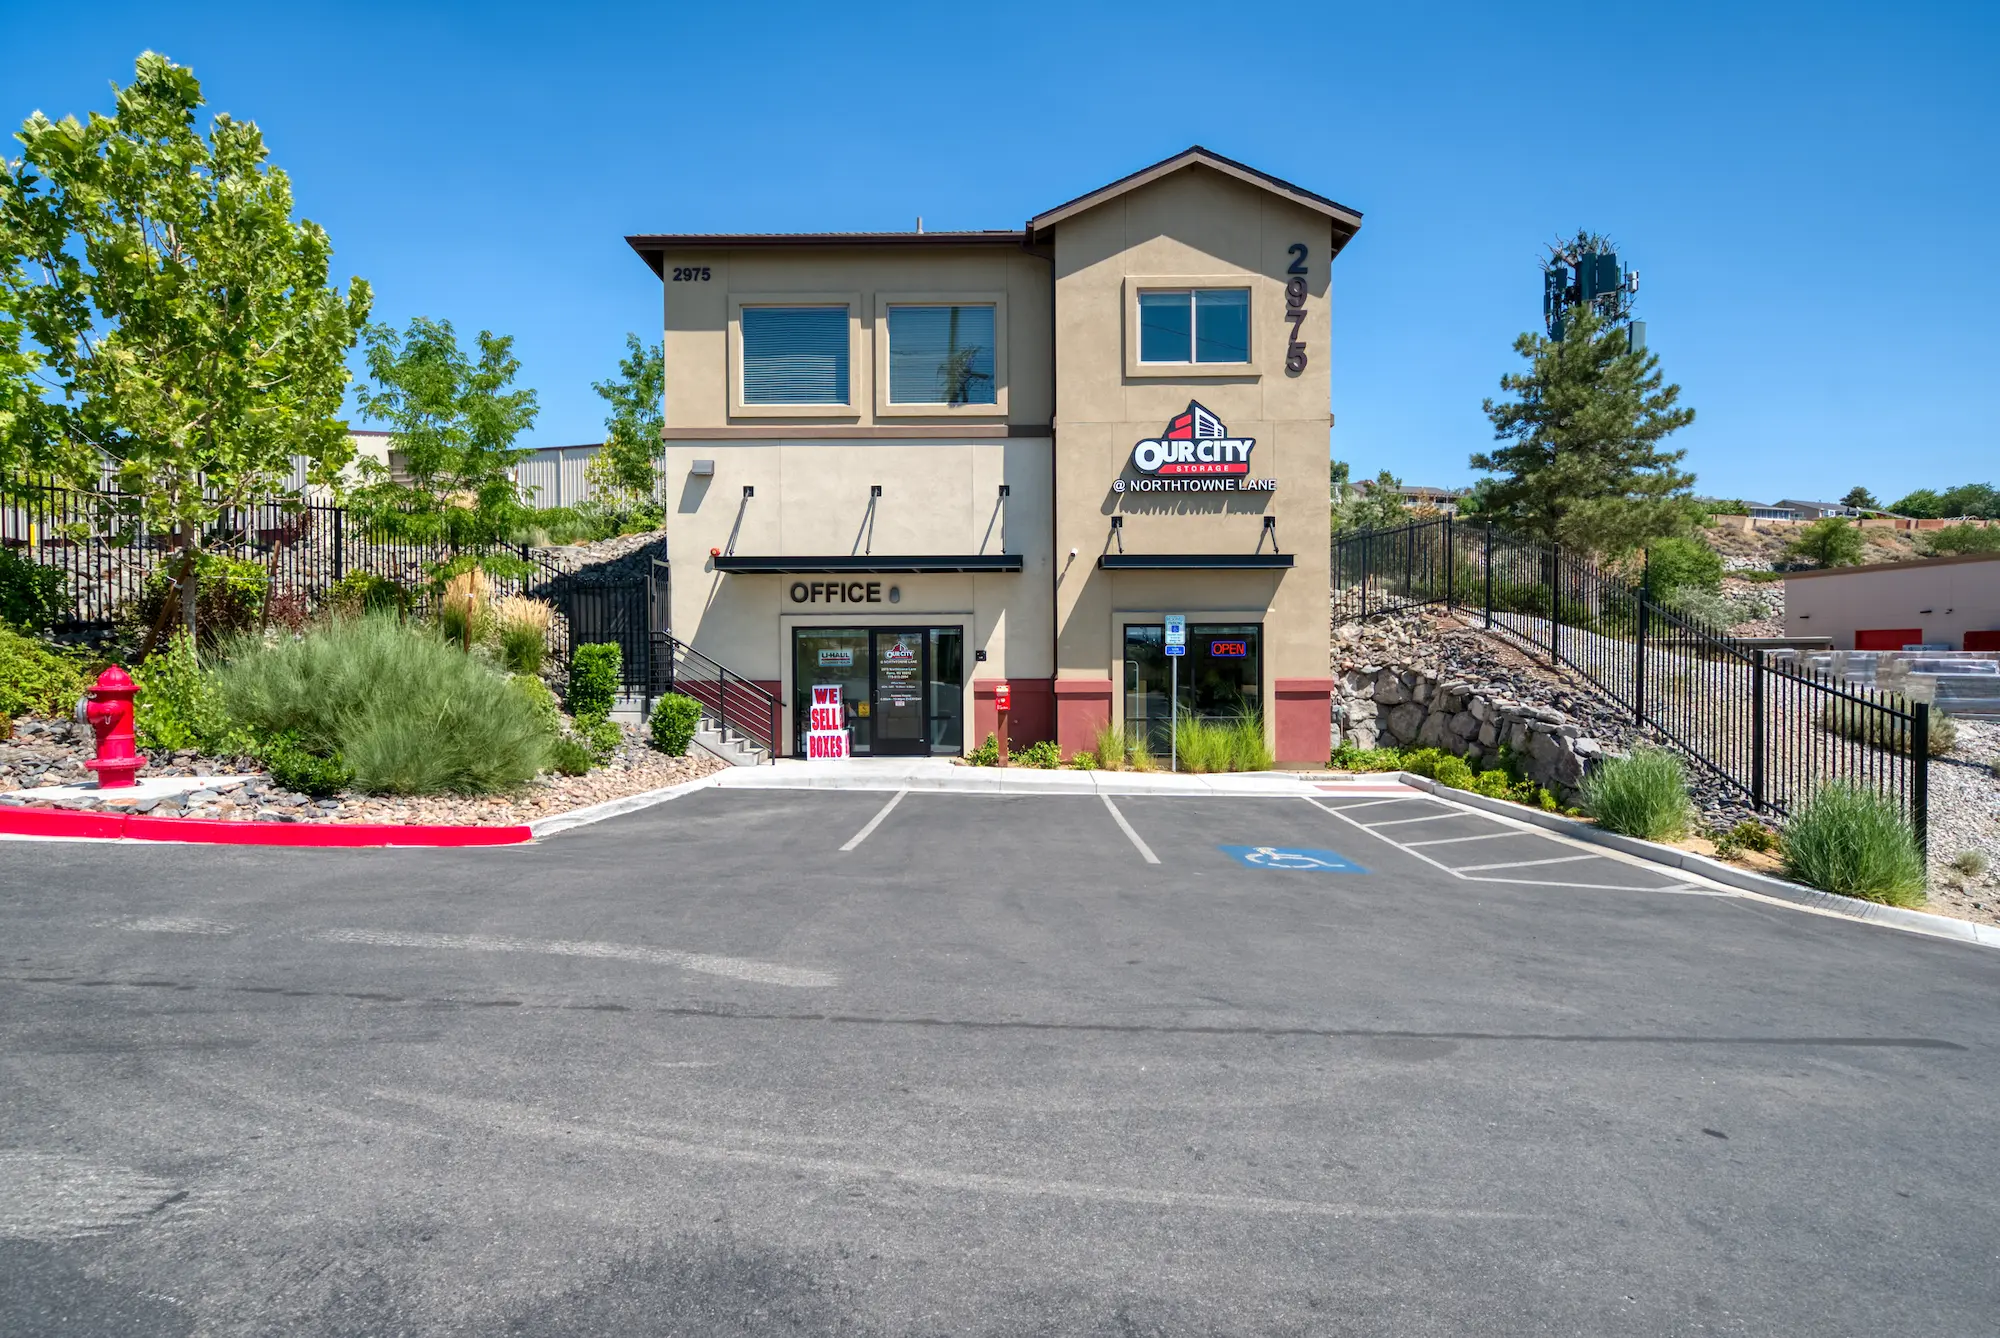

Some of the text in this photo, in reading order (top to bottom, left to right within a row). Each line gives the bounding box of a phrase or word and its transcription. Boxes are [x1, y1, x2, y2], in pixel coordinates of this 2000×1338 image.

[673, 267, 711, 282] 2975
[1287, 243, 1308, 372] 2975
[1130, 479, 1235, 492] NORTHTOWNE
[1238, 479, 1277, 492] LANE
[790, 582, 882, 604] OFFICE
[1213, 643, 1244, 655] OPEN
[814, 688, 838, 705] WE
[811, 708, 839, 731] SELL
[809, 735, 843, 758] BOXES
